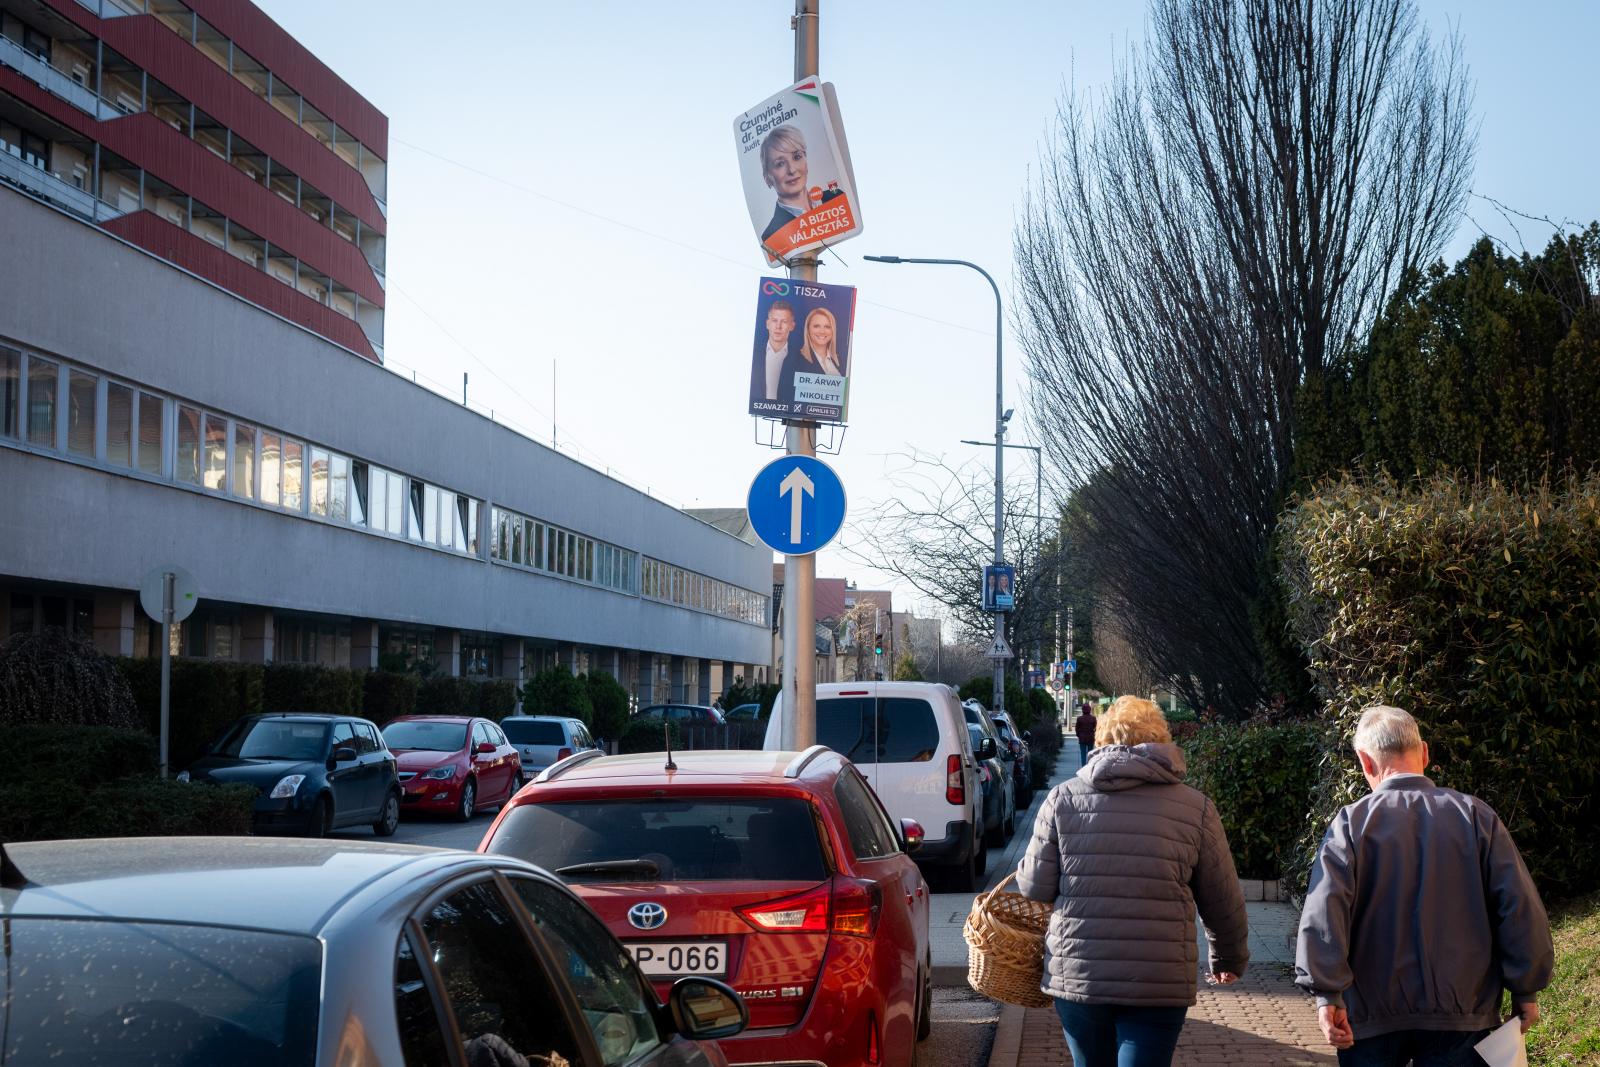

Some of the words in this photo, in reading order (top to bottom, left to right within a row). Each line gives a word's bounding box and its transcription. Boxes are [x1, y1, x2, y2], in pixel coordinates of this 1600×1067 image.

[740, 100, 783, 133] Czunyiné
[742, 132, 754, 144] dr.
[756, 107, 798, 138] Bertalan
[743, 139, 761, 154] Judit
[799, 218, 809, 229] A
[809, 204, 846, 225] BIZTOS
[789, 216, 849, 244] VÁLASZTÁS
[794, 286, 826, 298] TISZA
[799, 376, 813, 385] DR.
[814, 375, 841, 387] ÁRVAY
[753, 402, 789, 411] SZAVAZZ!
[799, 391, 841, 402] NIKOLETT
[624, 946, 719, 971] P-066
